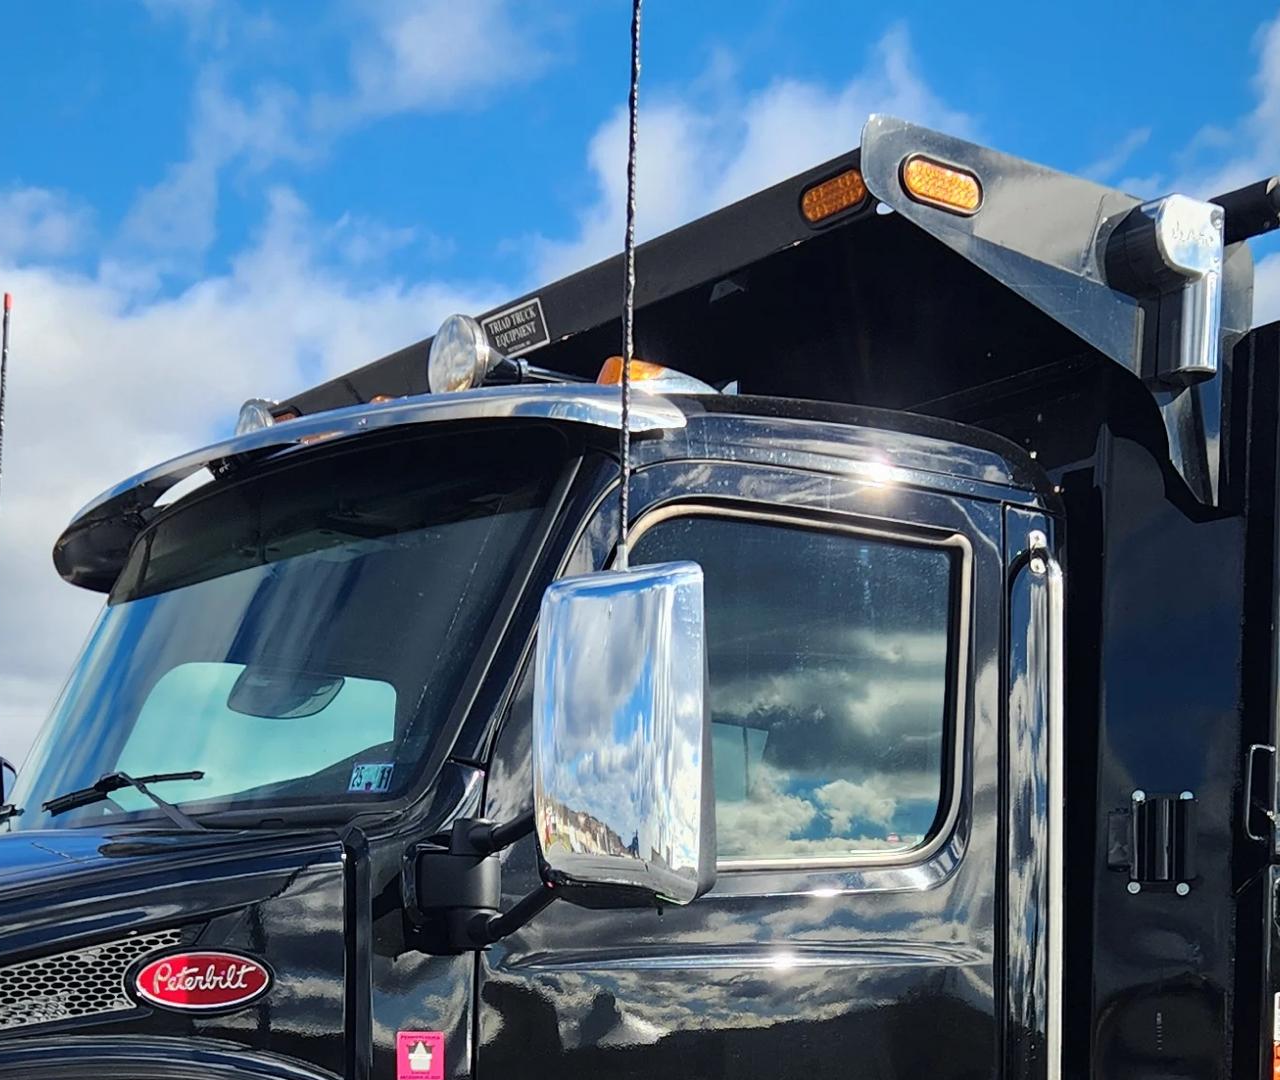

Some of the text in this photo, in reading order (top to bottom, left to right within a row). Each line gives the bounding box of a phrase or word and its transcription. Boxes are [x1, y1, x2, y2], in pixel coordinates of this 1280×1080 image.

[488, 305, 536, 335] TRIAD TRUCK
[495, 320, 536, 348] EQUIPMENT
[153, 963, 257, 994] Peterbilt
